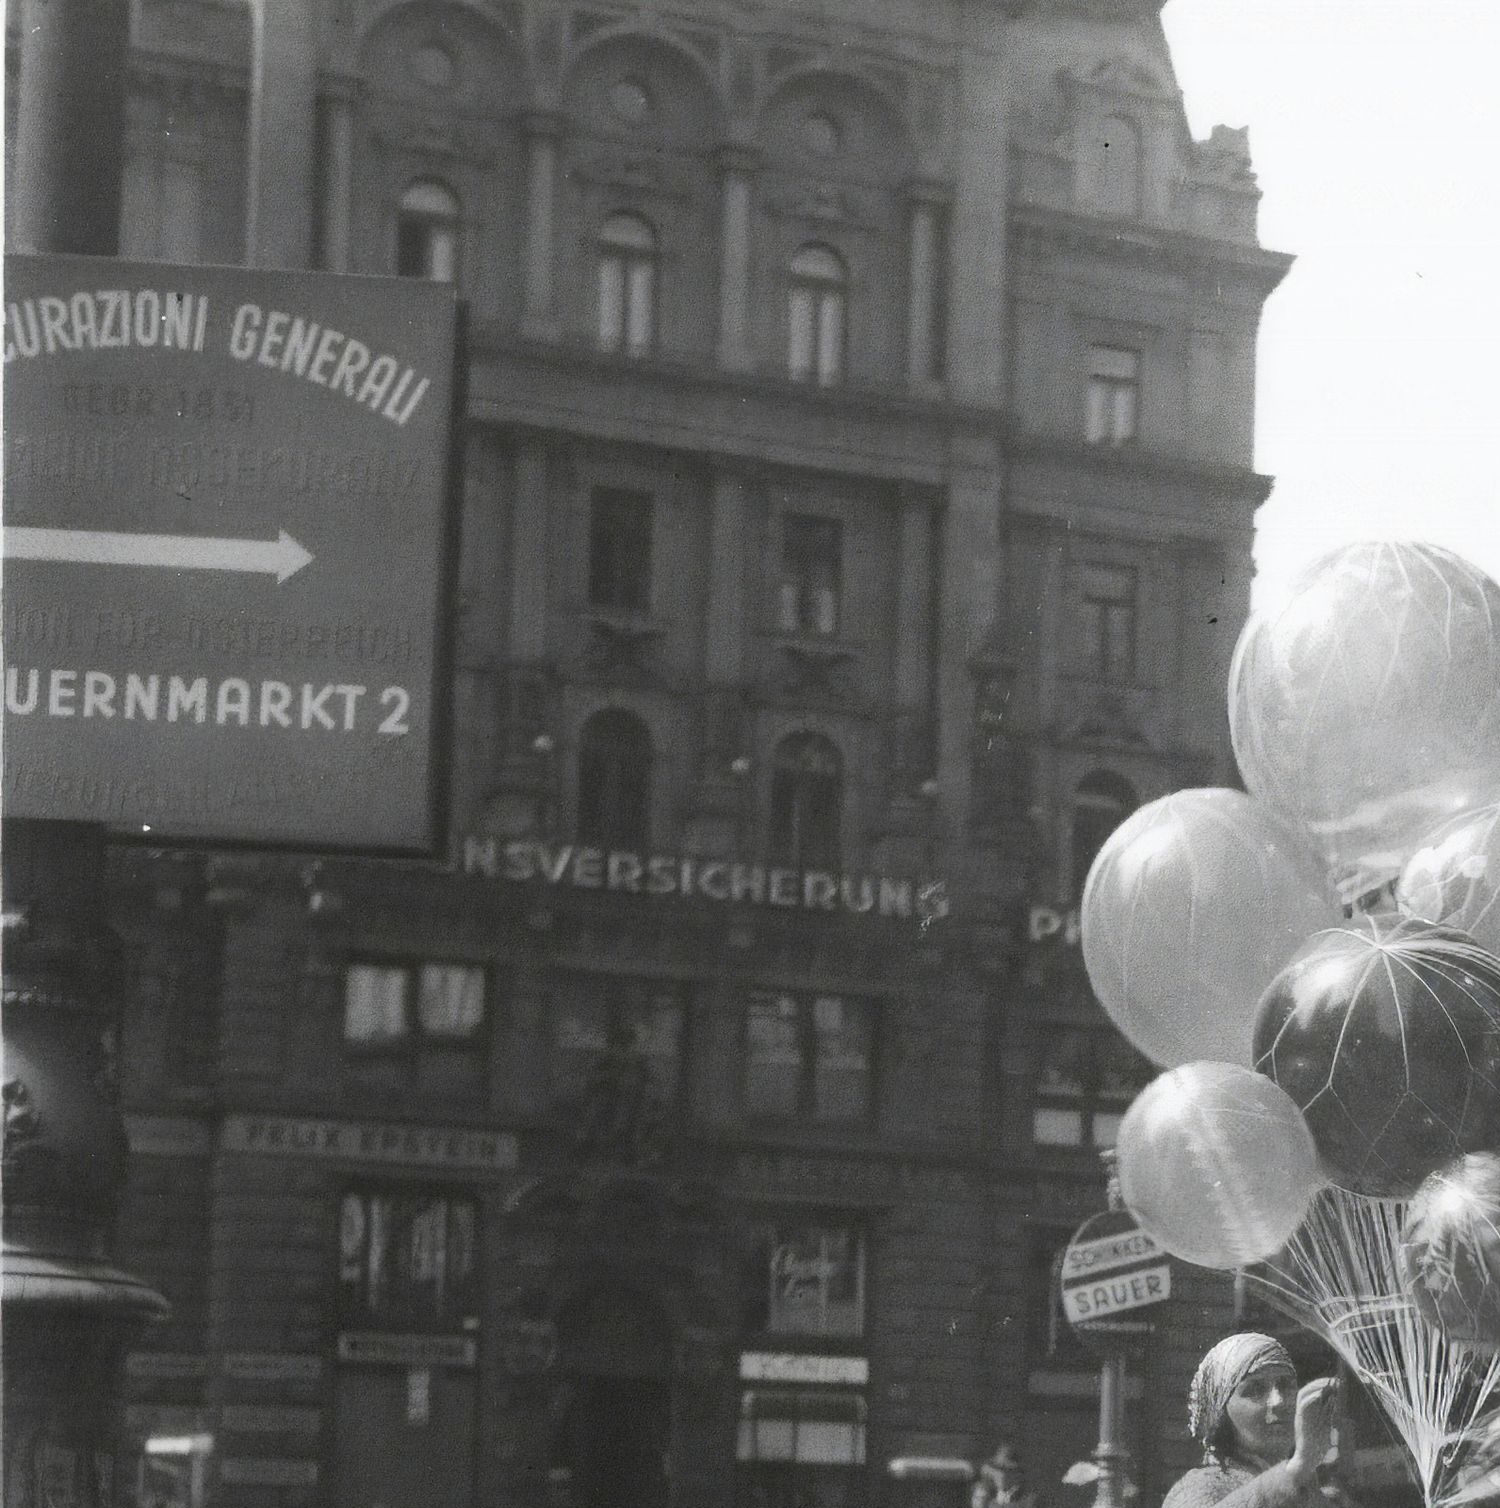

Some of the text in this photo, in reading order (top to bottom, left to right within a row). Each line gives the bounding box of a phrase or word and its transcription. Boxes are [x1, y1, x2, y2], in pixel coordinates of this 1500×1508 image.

[230, 303, 431, 425] GENERALI
[6, 668, 411, 736] UERNMARKT 2
[1073, 1273, 1163, 1317] SAUER
